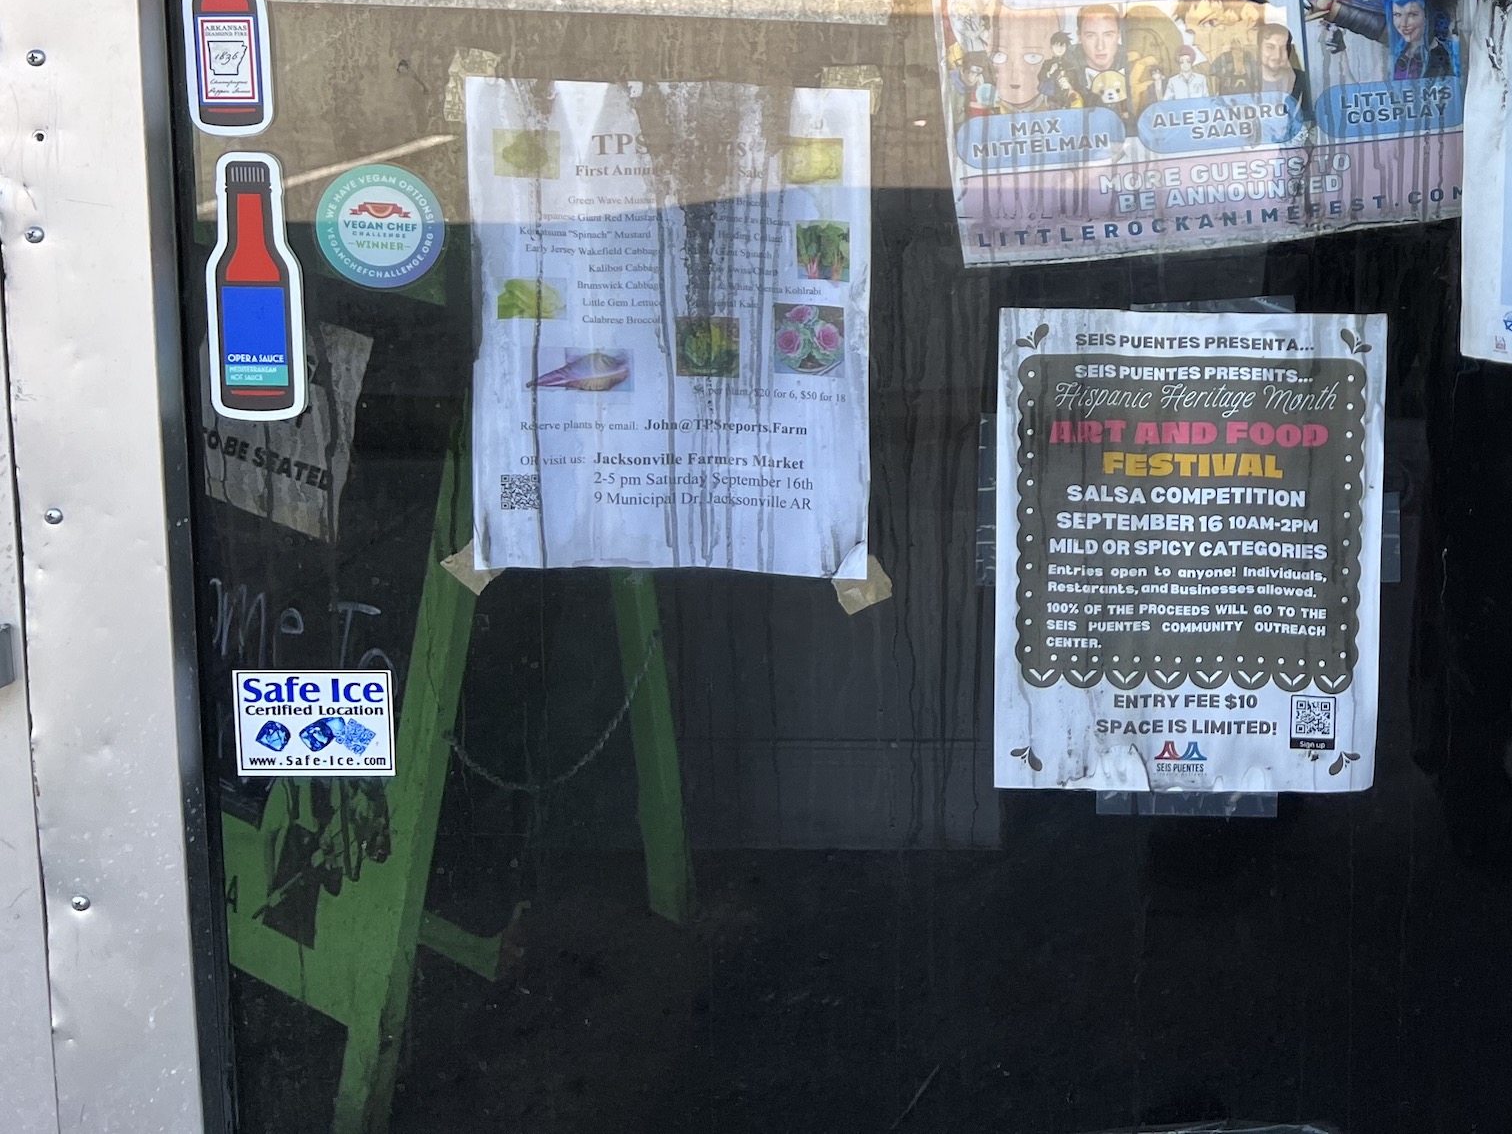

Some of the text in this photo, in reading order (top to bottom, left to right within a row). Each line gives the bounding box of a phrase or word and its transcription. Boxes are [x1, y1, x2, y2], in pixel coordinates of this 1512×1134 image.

[214, 51, 238, 65] 1836
[1340, 87, 1452, 110] LITTLE MS
[1153, 102, 1289, 129] ALEJANDRO
[1347, 102, 1446, 125] COSPLAY
[1010, 118, 1061, 137] MAX
[1191, 121, 1252, 139] SAAB
[972, 133, 1109, 158] MITTELMAN
[1100, 153, 1351, 195] MORE GUESTS TO
[336, 181, 357, 202] HAVE
[358, 174, 397, 185] VEGAN
[1118, 174, 1343, 213] BE ANNOUNCED
[344, 220, 417, 231] VEGAN CHEF
[326, 227, 434, 278] VEGANCHEFCHALLENGE.ORG
[355, 240, 405, 250] WINNER
[1076, 334, 1314, 351] SEIS PUENTES PRESENTA...
[228, 354, 284, 363] OPERA SAUCE
[1075, 365, 1313, 383] SEIS PUENTES PRESENTS...
[1055, 381, 1339, 418] Hispanic Heritage Month
[1050, 420, 1328, 447] ART AND FOOD
[594, 452, 804, 469] Jacksonville Farmers Market
[1103, 452, 1283, 479] FESTIVAL
[594, 473, 814, 490] 2-5 pm Saturday September 16th
[594, 492, 812, 510] 9 Municipal Jacksonville AR
[1067, 485, 1306, 508] SALSA COMPETITION
[1057, 512, 1318, 533] SEPTEMBER 16 10AM-2PM
[1050, 538, 1328, 559] MILD OR SPICY CATEGORIES
[1048, 565, 1327, 582] Entries open to anyone! Individuals,
[1048, 582, 1317, 598] Restarants, and Businesses allowed.
[1046, 603, 1326, 619] 100% OF THE PROCEEDS WILL GO TO THE
[1047, 620, 1326, 636] SEIS PUENTES COMMUNITY OUTREACH
[1046, 637, 1101, 648] CENTER.
[242, 676, 384, 703] Safe Ice
[245, 705, 384, 716] Certified Location
[1114, 694, 1257, 709] ENTRY FEE $10
[1096, 719, 1277, 736] SPACE IS LIMITED!
[249, 755, 386, 766] www.Safe-Ice.com
[1156, 763, 1204, 773] SEIS PUENTES
